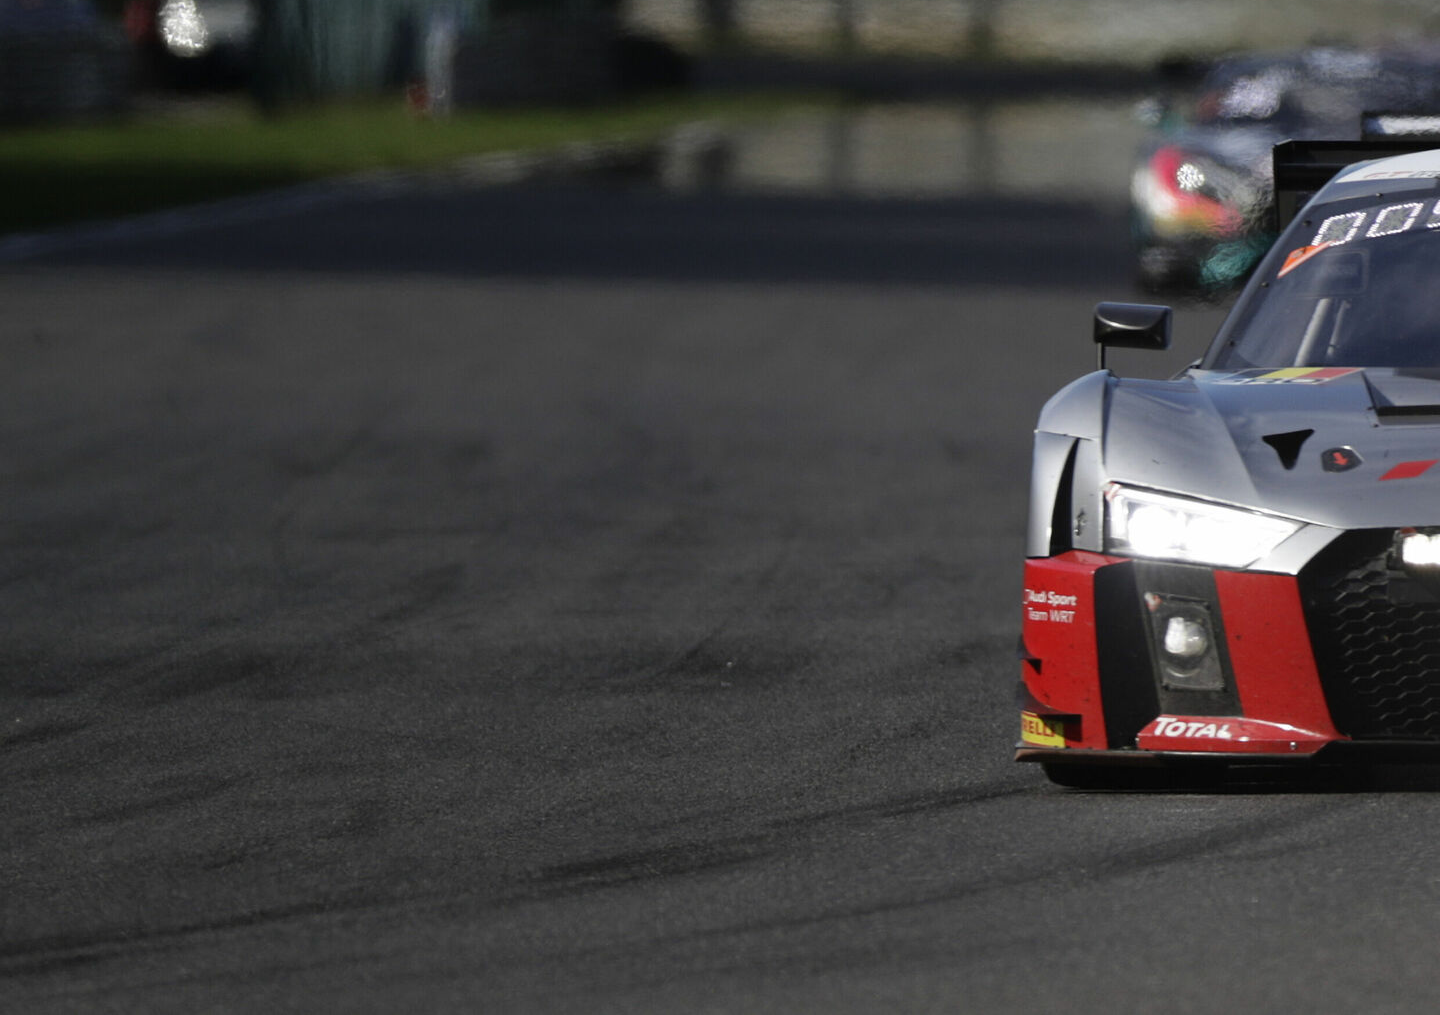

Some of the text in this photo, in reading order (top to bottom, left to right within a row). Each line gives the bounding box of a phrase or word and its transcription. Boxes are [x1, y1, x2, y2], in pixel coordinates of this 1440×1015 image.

[1047, 590, 1078, 607] Sport
[1049, 609, 1076, 623] WRT
[1154, 716, 1232, 739] TOTAL
